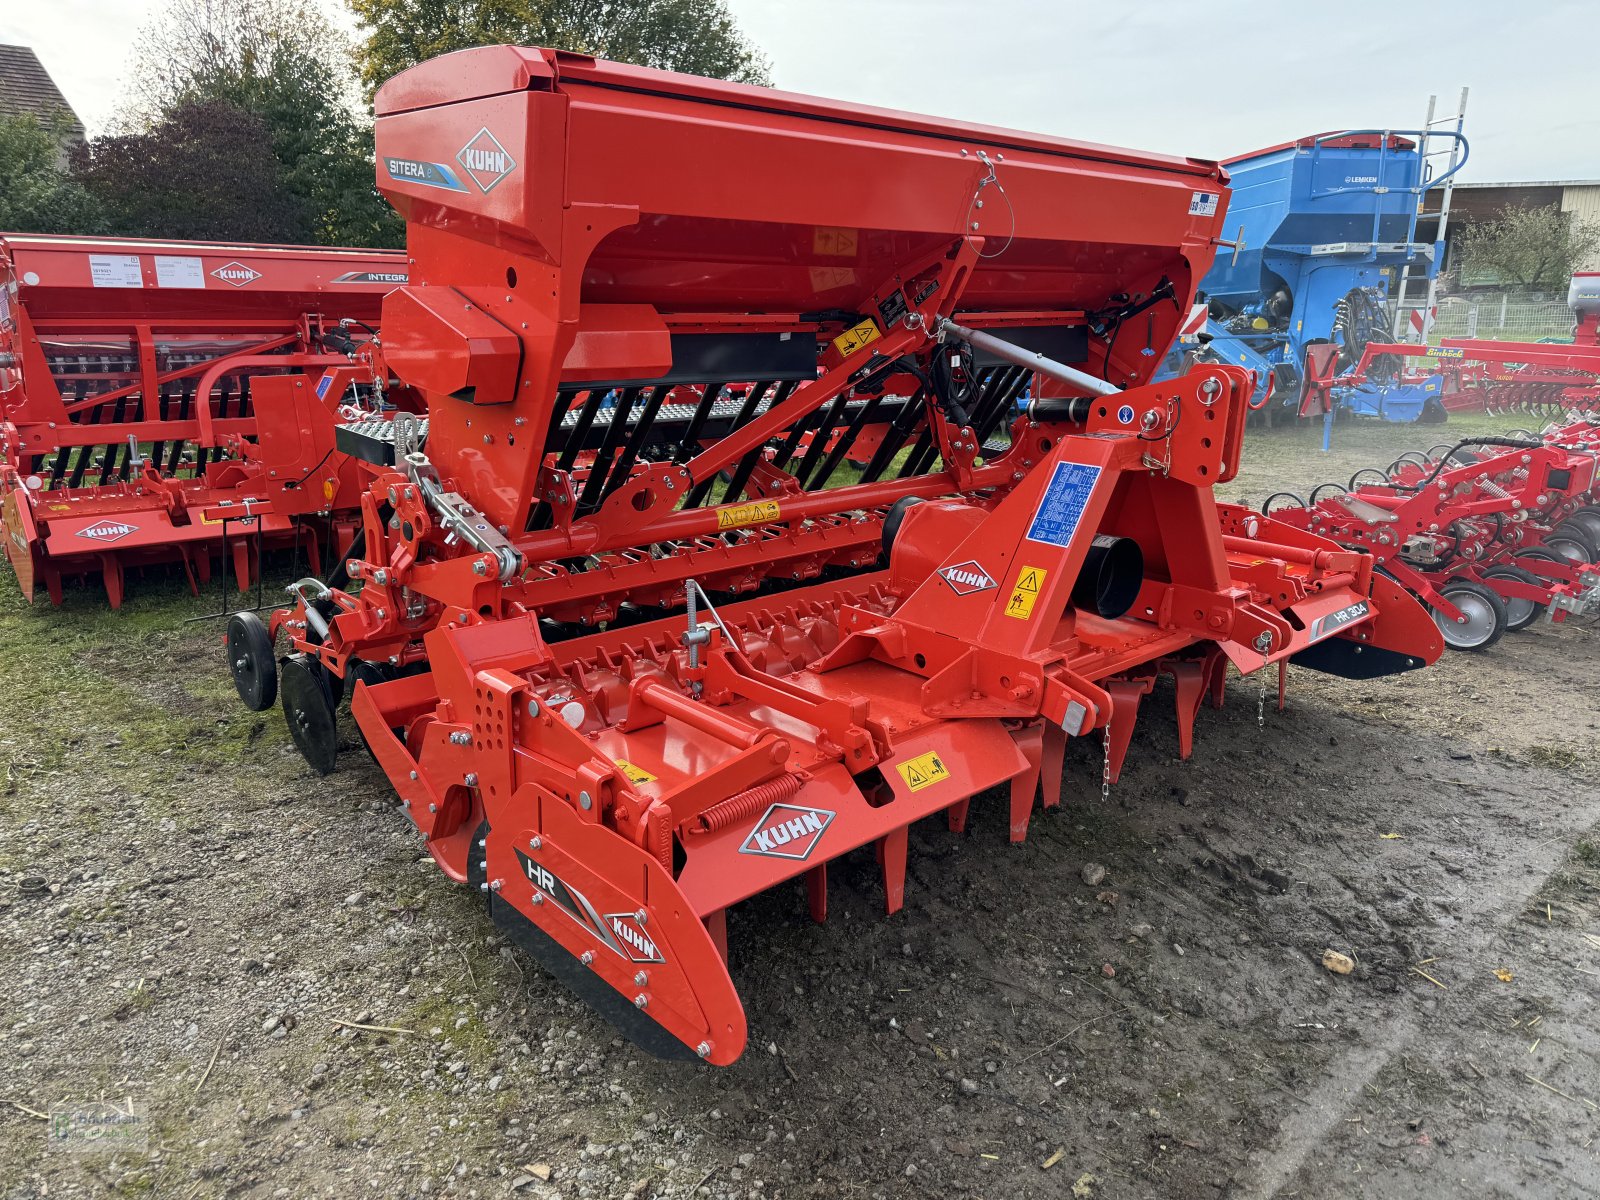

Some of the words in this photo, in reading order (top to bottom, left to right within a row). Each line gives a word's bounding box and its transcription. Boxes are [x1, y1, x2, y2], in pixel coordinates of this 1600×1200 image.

[389, 160, 425, 178] SITERA
[465, 148, 505, 173] KUHN
[219, 269, 254, 280] KUHN
[1426, 348, 1464, 358] Einböck
[86, 525, 129, 538] KUHN
[946, 568, 989, 588] KUHN
[1333, 610, 1350, 623] HR
[1347, 603, 1367, 617] 304
[753, 811, 824, 852] KUHN
[527, 858, 556, 897] HR
[613, 916, 654, 960] KUHN
